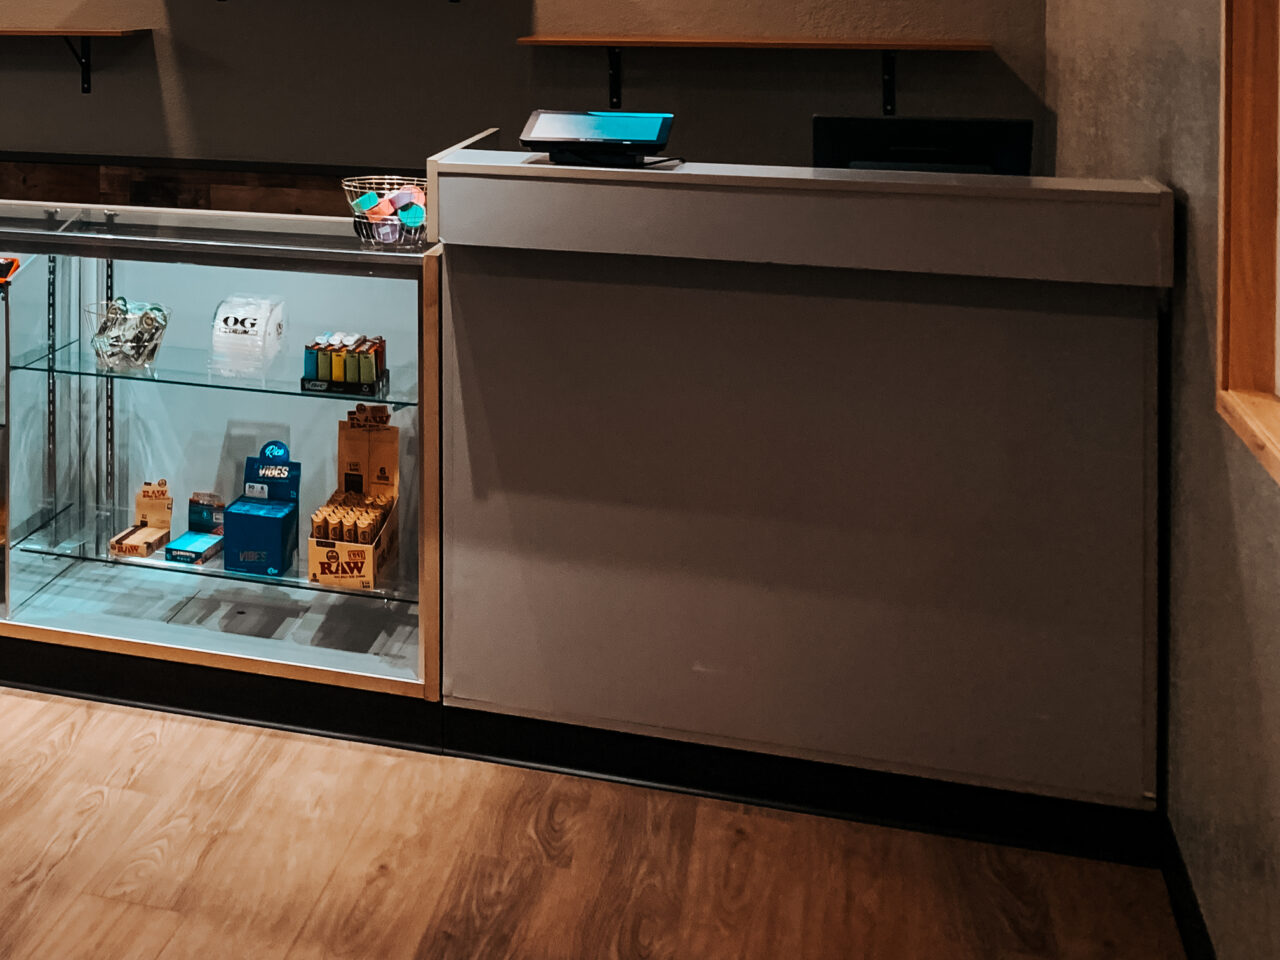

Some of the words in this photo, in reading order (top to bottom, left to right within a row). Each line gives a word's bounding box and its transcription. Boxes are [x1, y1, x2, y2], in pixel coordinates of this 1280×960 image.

[222, 316, 258, 329] OG
[258, 465, 289, 478] VIBES
[142, 489, 168, 499] RAW
[116, 545, 140, 554] RAW
[239, 551, 267, 562] VIBES
[319, 561, 365, 575] RAW
